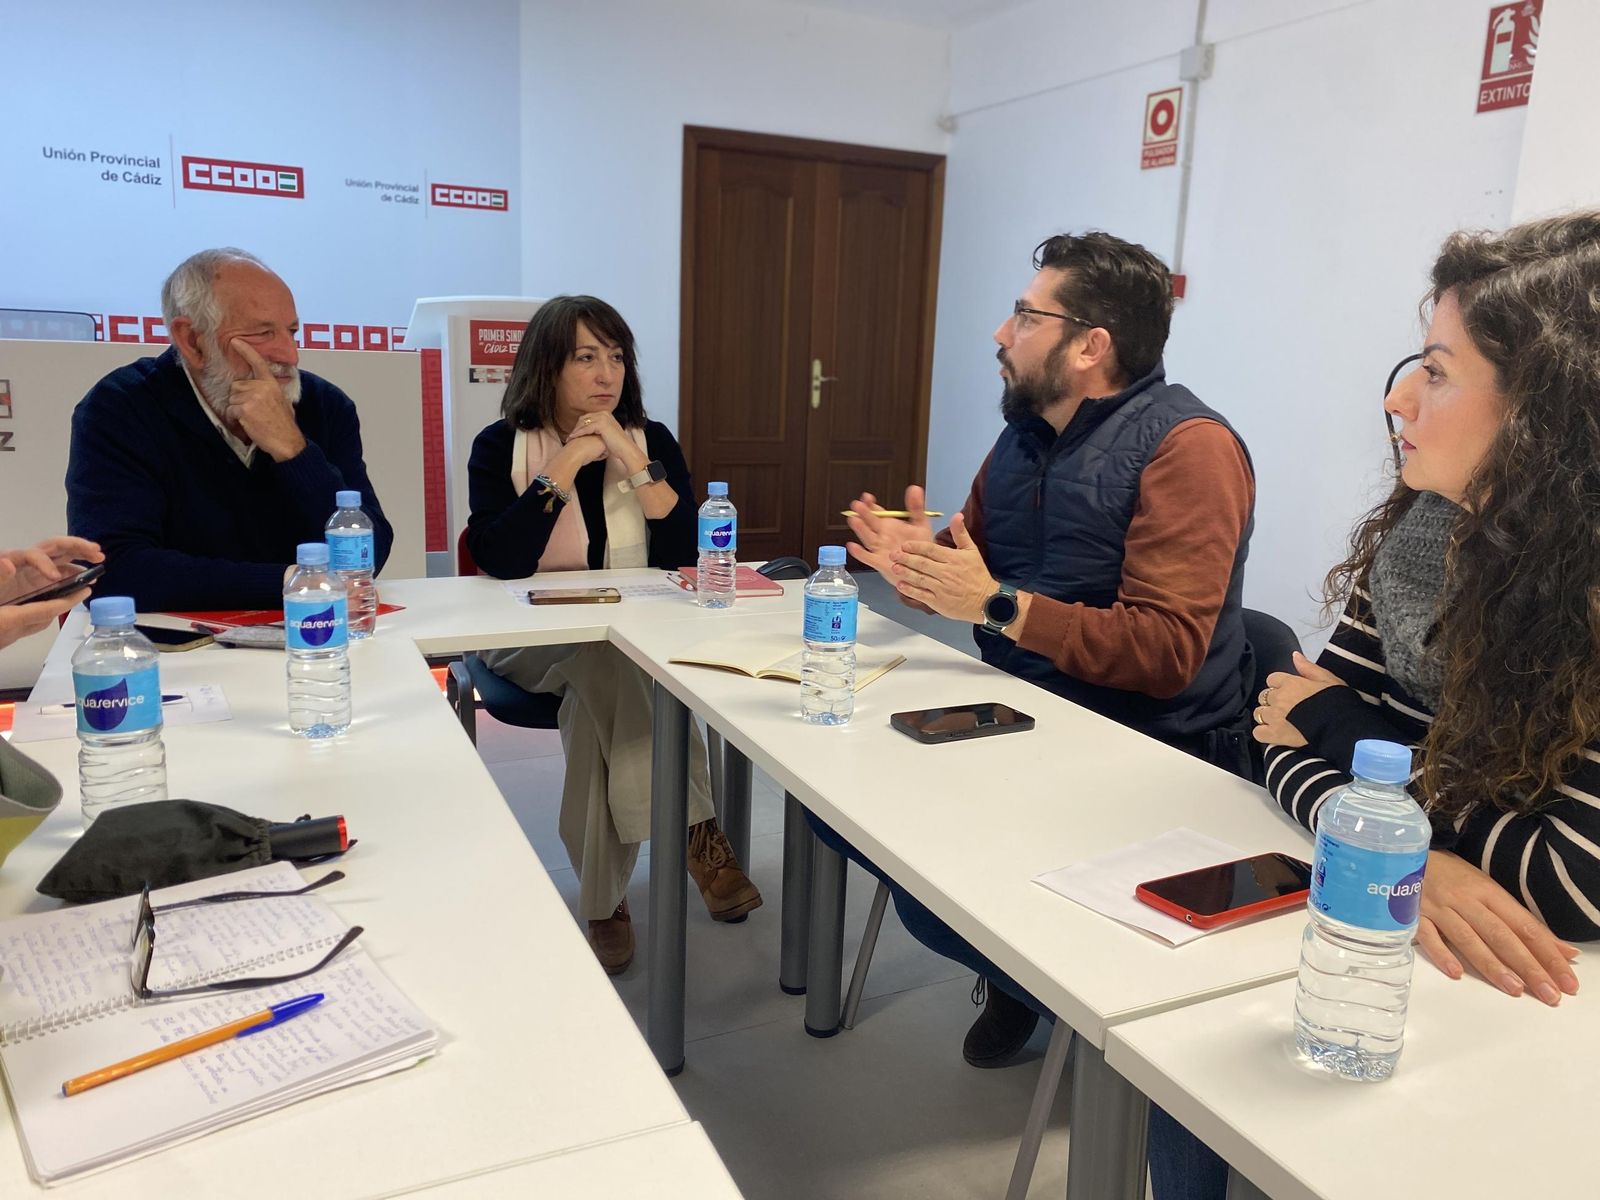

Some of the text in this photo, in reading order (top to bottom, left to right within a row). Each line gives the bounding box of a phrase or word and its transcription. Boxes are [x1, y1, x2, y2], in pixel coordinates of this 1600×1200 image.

[1480, 82, 1531, 105] EXTINTO
[42, 146, 161, 169] Unión Provincial
[101, 169, 162, 186] de Cádiz
[345, 178, 420, 193] Unión Provincial
[381, 193, 420, 205] de Cádiz
[109, 315, 170, 343] CC
[296, 323, 389, 351] COO
[478, 328, 505, 342] PRIMER
[1366, 879, 1424, 901] aquase
